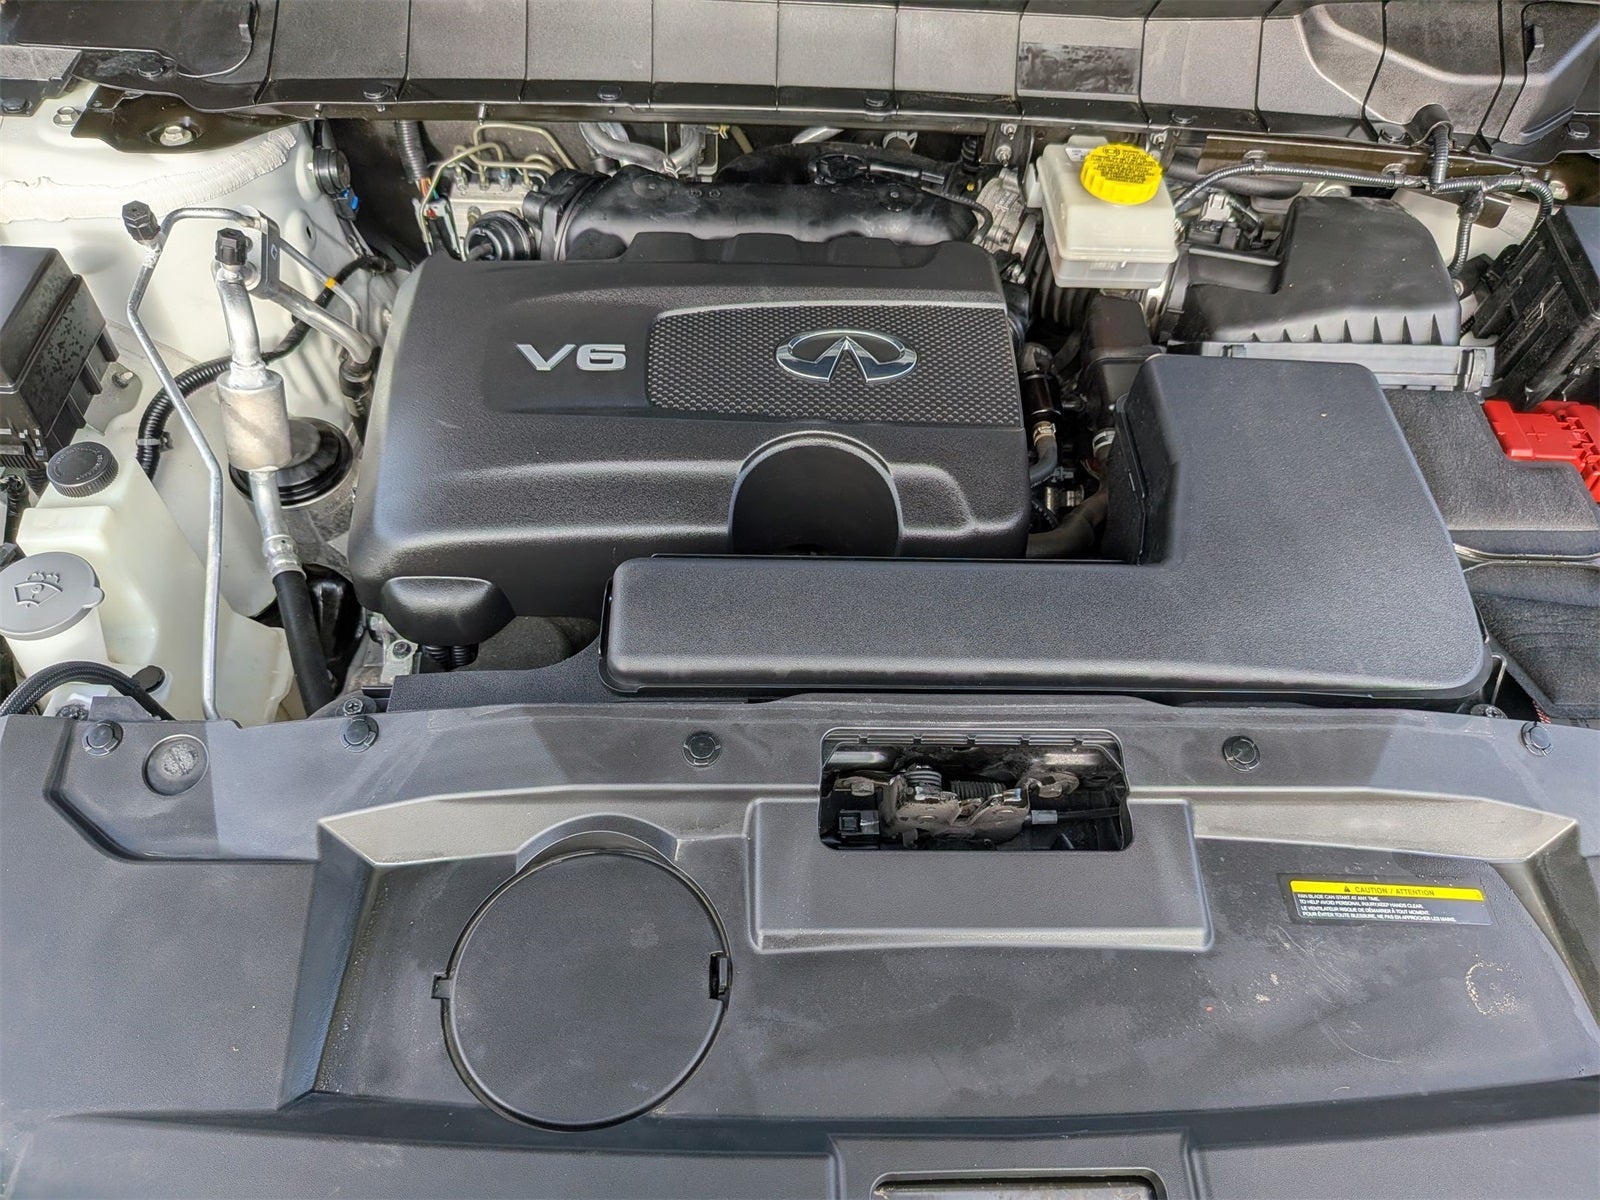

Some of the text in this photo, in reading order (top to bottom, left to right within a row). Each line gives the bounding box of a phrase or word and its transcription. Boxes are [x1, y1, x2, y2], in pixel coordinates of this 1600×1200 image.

[516, 344, 627, 371] V6
[1354, 886, 1388, 894] CAUTION
[1395, 888, 1435, 896] ATTENTION
